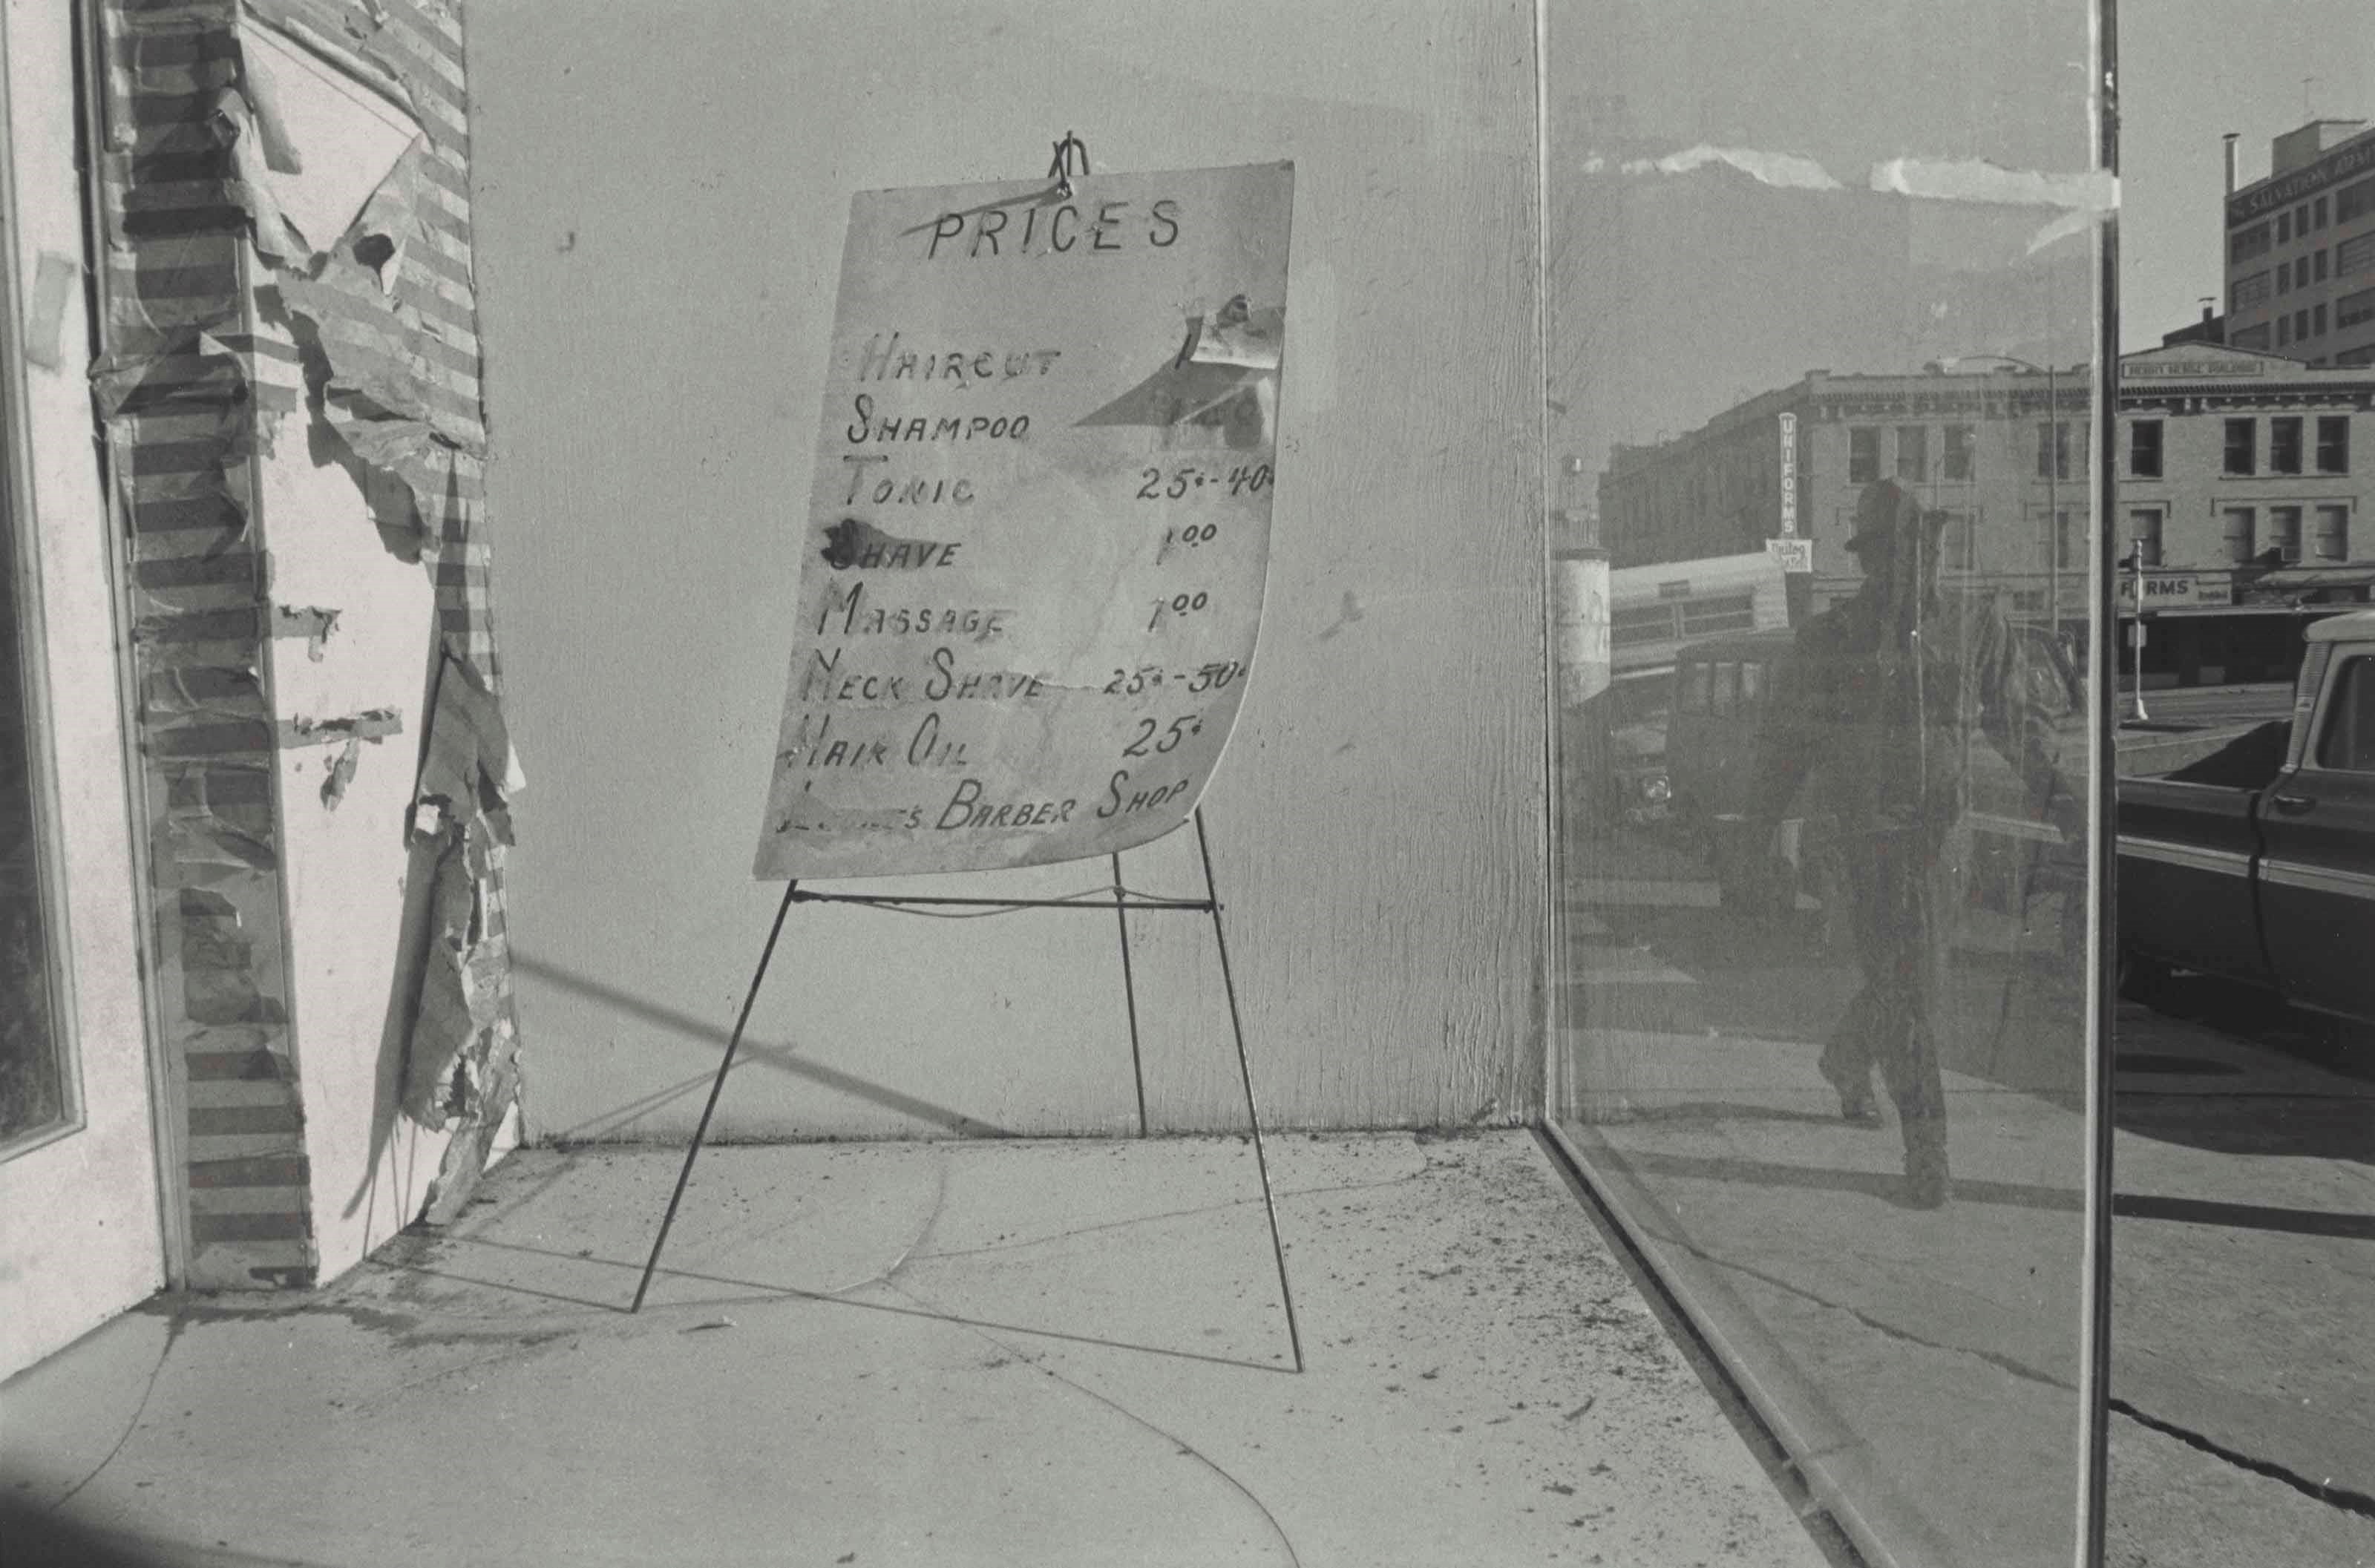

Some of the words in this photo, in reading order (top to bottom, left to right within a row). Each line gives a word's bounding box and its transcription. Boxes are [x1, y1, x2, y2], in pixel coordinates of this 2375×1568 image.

[928, 199, 1180, 260] PRICES
[847, 393, 1030, 445] SHAMPOO
[843, 455, 974, 506] TONIC
[1783, 418, 1794, 533] UNIFORMS
[801, 648, 903, 701] NECK
[935, 778, 1076, 830] BARBER
[1097, 769, 1189, 818] SHOP
